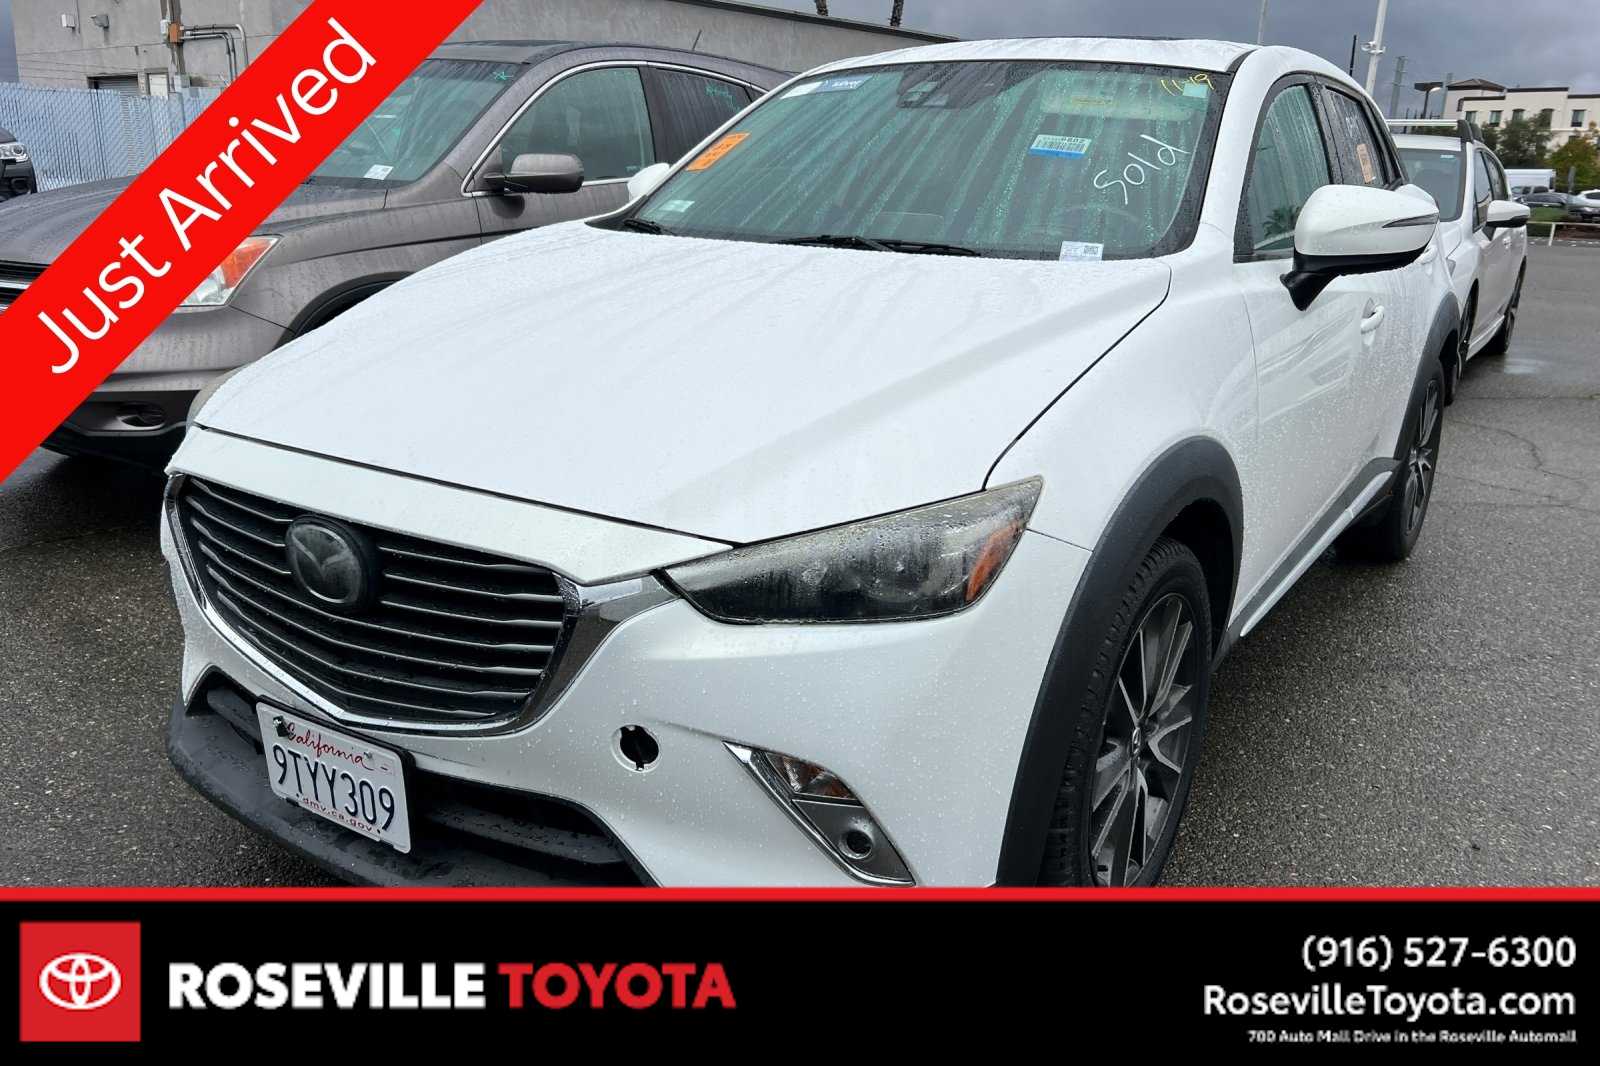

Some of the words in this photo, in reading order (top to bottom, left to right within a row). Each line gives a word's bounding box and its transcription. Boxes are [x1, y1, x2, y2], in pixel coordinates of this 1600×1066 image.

[1093, 134, 1191, 205] Sold
[286, 721, 375, 772] California
[272, 744, 396, 831] 9TYY309
[302, 797, 373, 833] dmv.ca.gov
